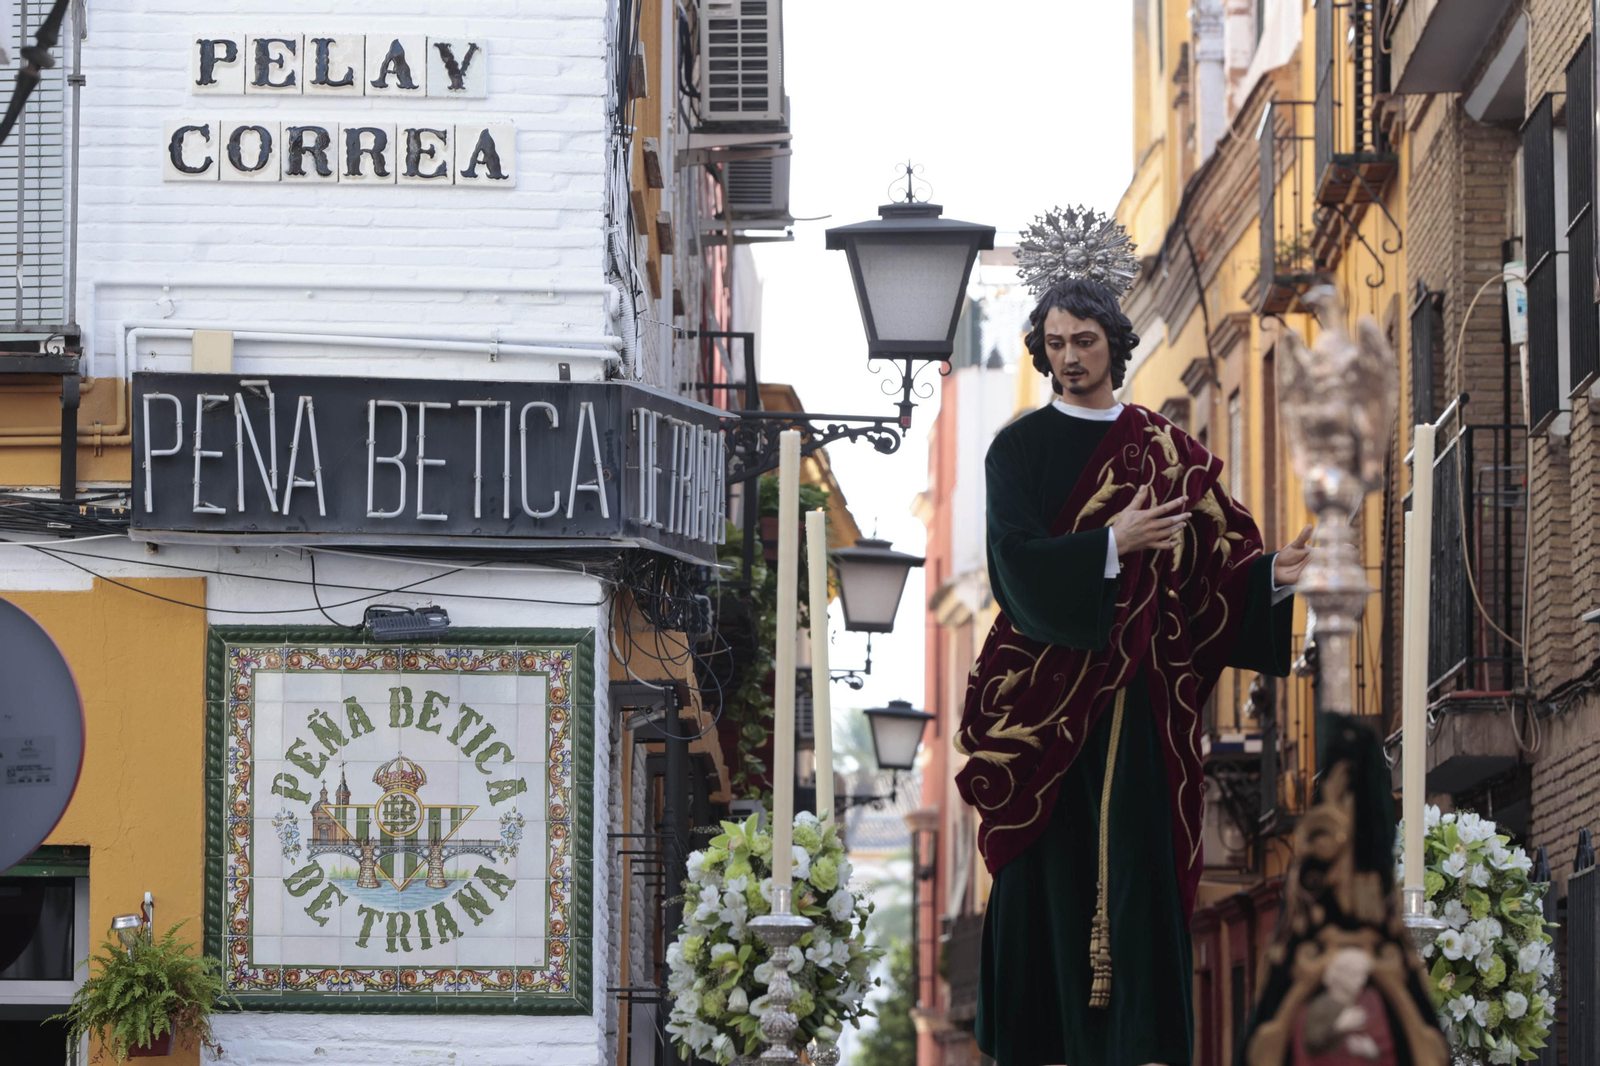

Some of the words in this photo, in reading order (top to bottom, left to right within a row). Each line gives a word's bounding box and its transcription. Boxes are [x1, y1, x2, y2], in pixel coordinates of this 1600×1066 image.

[195, 37, 483, 92] PELAY
[169, 123, 510, 181] CORREA
[366, 399, 610, 521] BETICA
[270, 695, 376, 805] PEÑA
[388, 686, 528, 807] BETICA
[282, 859, 349, 928] DE
[354, 864, 517, 954] TRIANA
